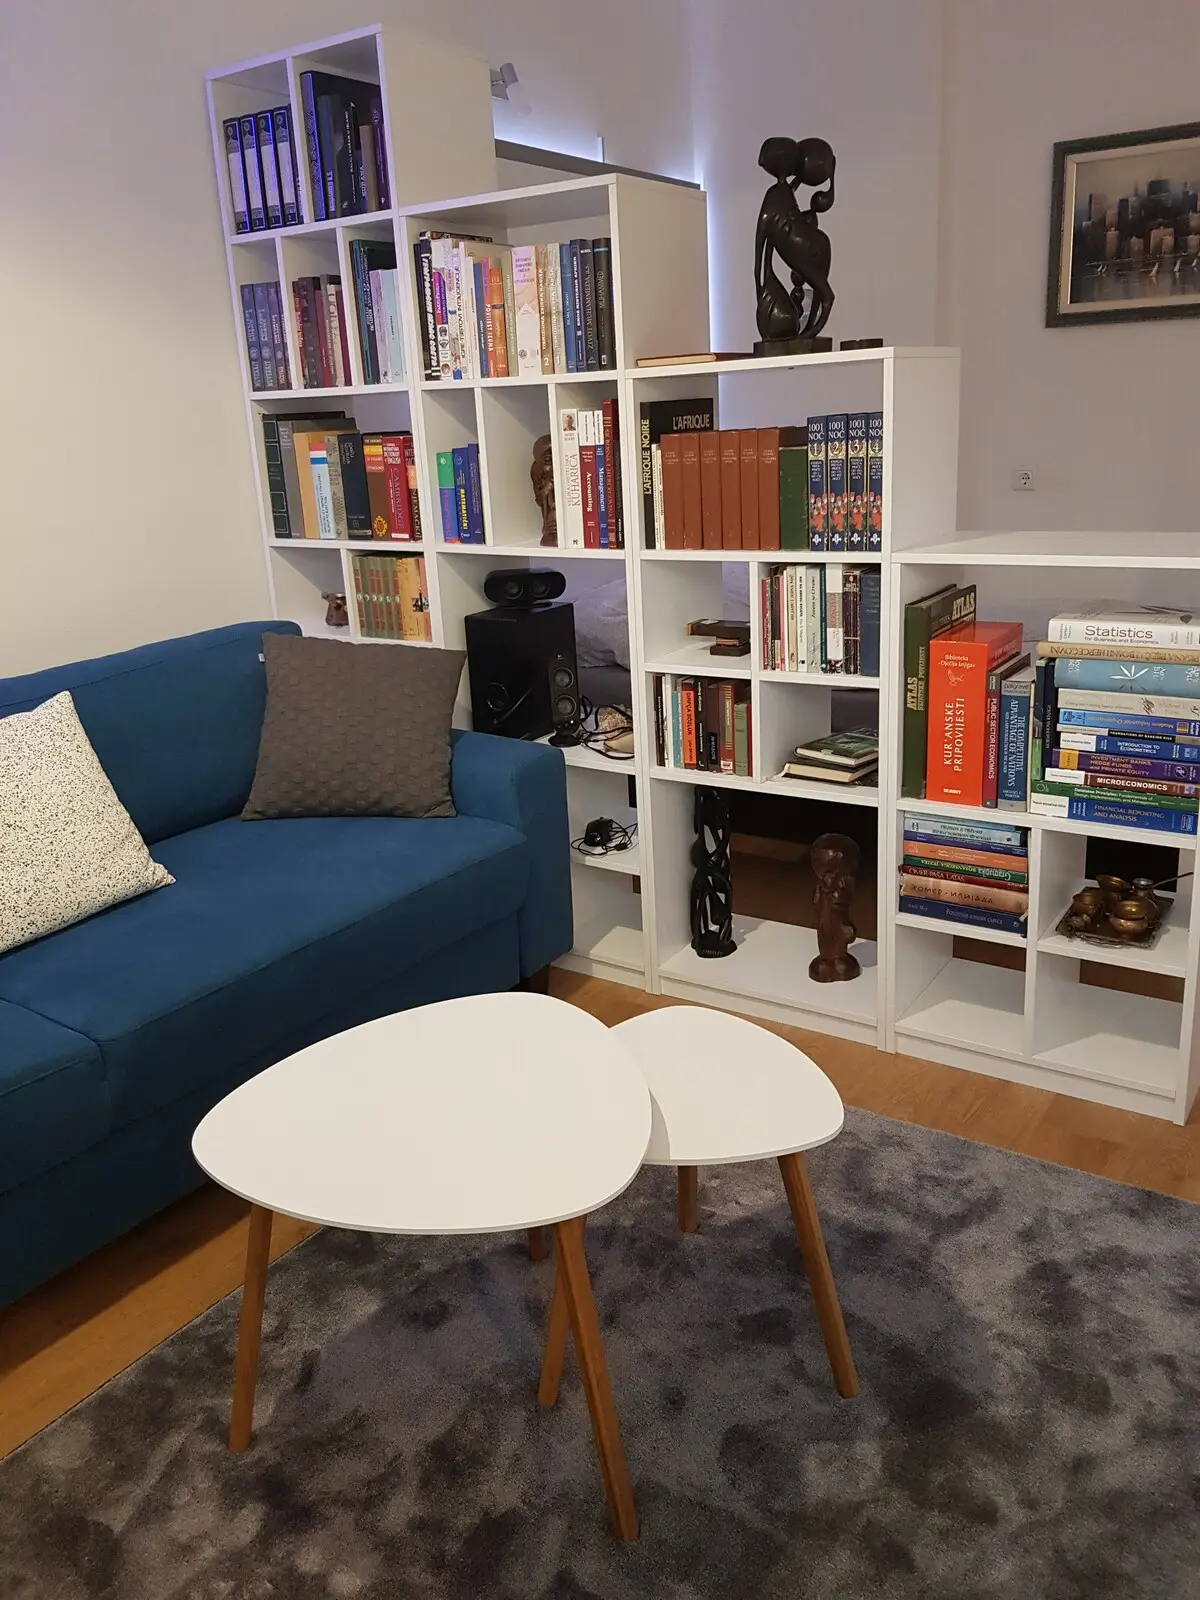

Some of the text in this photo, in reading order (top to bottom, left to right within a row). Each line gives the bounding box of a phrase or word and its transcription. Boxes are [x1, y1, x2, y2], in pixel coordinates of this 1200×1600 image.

[544, 358, 550, 366] 2
[672, 413, 710, 430] L'AFRIQUE
[808, 423, 824, 432] 1001
[828, 421, 844, 430] 1001
[849, 420, 865, 428] 1001
[870, 419, 882, 428] 100
[813, 444, 818, 456] 1
[833, 442, 840, 454] 2
[853, 440, 860, 454] 3
[873, 440, 879, 452] 4
[641, 419, 652, 494] L'AFRIQUE NOIRE
[570, 453, 581, 506] KUHARICA
[393, 468, 404, 530] CAMBRIDGE
[951, 592, 975, 620] ATLAS
[1085, 625, 1153, 638] Statistics
[906, 677, 918, 710] ATLAS
[943, 702, 954, 765] KUR'ANSKE
[954, 698, 965, 771] PRIPOVIJESTI
[1008, 699, 1019, 787] ADVANTAGE OF NATIONS
[1016, 716, 1025, 772] THE COMPETITIVE
[1090, 755, 1129, 763] INVESTMENT
[1097, 778, 1168, 791] MICROECONOMICS
[1094, 805, 1165, 818] FINANCIAL REPORTING
[1109, 814, 1137, 822] ANALYSIS
[946, 873, 965, 882] LATAS
[978, 868, 1012, 881] Gramatika
[911, 884, 943, 894] ХОМЕР
